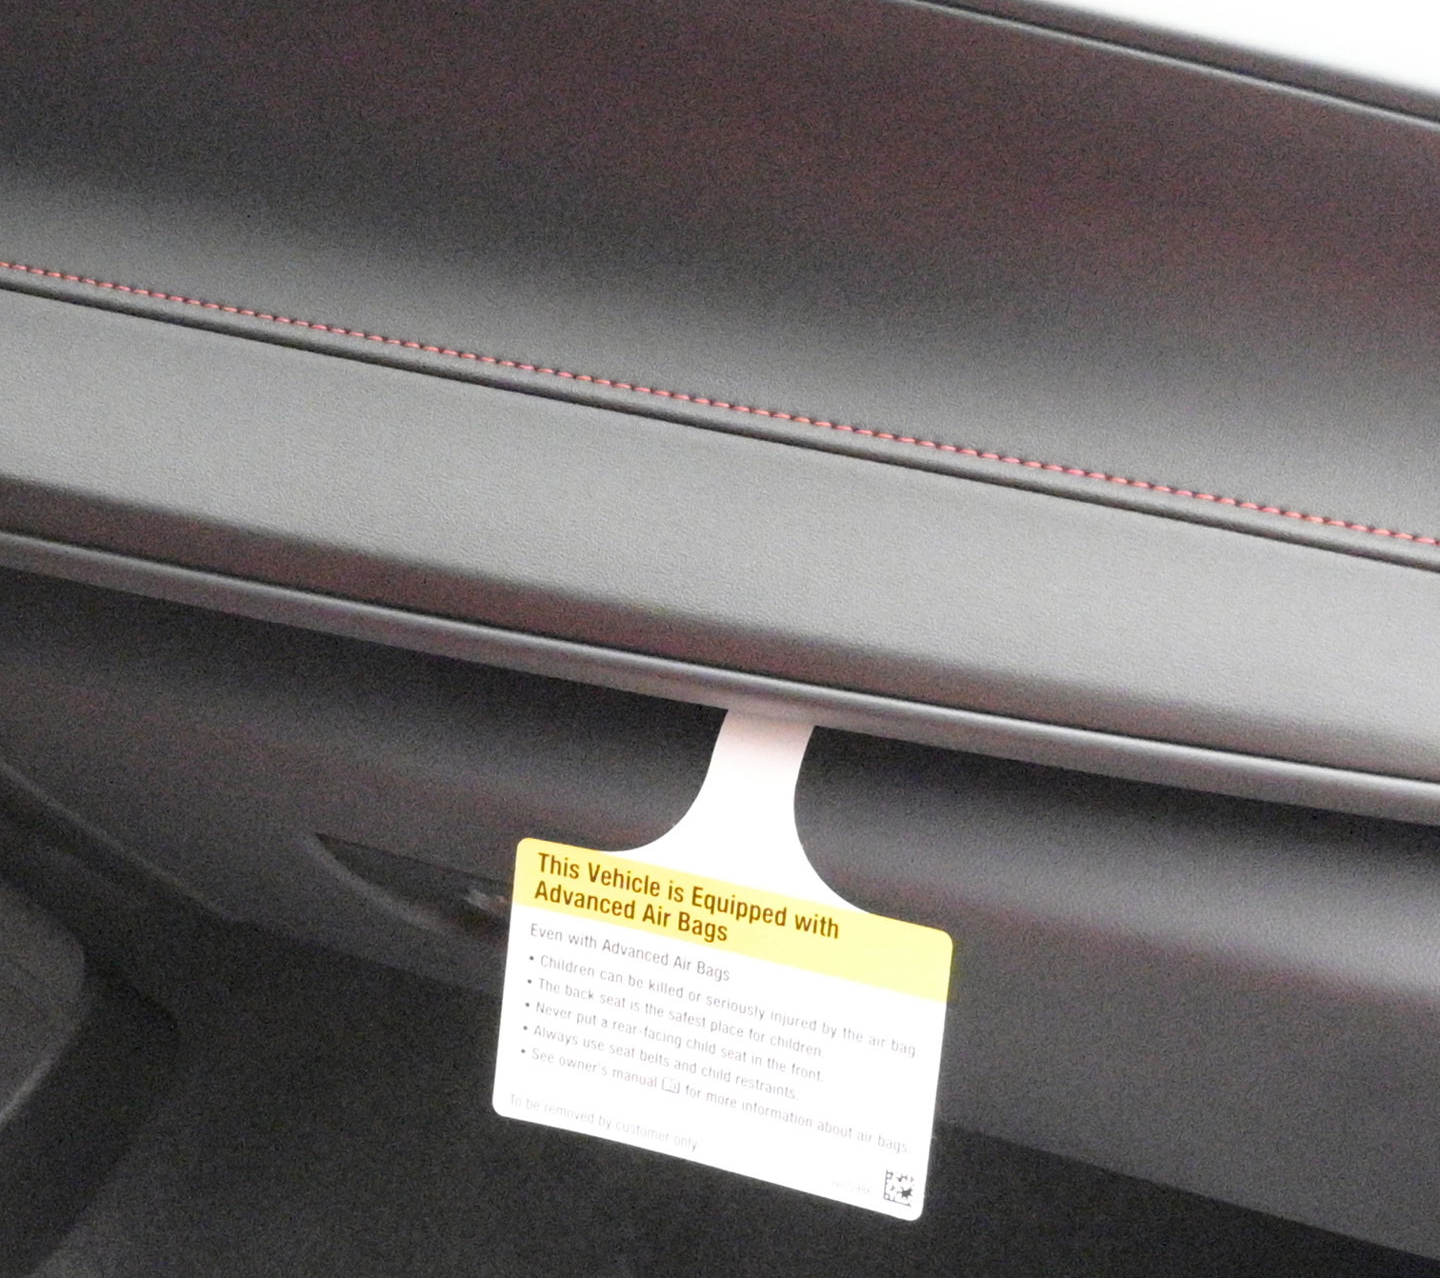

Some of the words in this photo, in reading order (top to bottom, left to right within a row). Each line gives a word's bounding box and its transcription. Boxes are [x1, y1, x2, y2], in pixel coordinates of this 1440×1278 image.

[533, 878, 637, 921] Advanced
[641, 902, 672, 929] Air
[677, 909, 728, 945] Bags
[537, 850, 580, 881] This
[587, 860, 661, 899] Vehicle
[667, 878, 685, 905] is
[691, 884, 788, 929] Equipped
[794, 912, 839, 941] with
[529, 921, 563, 944] Even
[567, 932, 598, 951] with
[601, 937, 670, 968] Advanced
[672, 953, 693, 973] Air
[696, 959, 731, 984] Bags
[535, 999, 574, 1021] Never
[576, 1011, 597, 1028] put
[600, 1017, 609, 1030] a
[611, 1019, 683, 1051] rear-facing
[685, 1036, 717, 1057] child
[720, 1046, 748, 1065] seat
[750, 1054, 763, 1068] in
[766, 1055, 787, 1074] the
[538, 975, 561, 996] The
[564, 982, 595, 1002] back
[599, 992, 627, 1010] seat
[629, 999, 641, 1013] is
[644, 1001, 665, 1019] the
[667, 1009, 707, 1031] safest
[709, 1018, 745, 1040] place
[748, 1026, 766, 1045] for
[539, 953, 596, 979] Children
[599, 969, 624, 986] can
[627, 972, 644, 991] be
[647, 977, 685, 1000] killed
[687, 989, 703, 1004] or
[705, 994, 766, 1022] seriously
[770, 1009, 818, 1033] injured
[821, 1020, 838, 1041] by
[842, 1025, 864, 1045] the
[867, 1033, 887, 1049] air
[532, 1023, 579, 1048] Always
[582, 1036, 605, 1053] use
[608, 1042, 636, 1060] seat
[639, 1047, 670, 1069] belts
[673, 1058, 698, 1076] and
[700, 1064, 732, 1085] child
[531, 1045, 555, 1065] See
[558, 1054, 608, 1078] owner's
[611, 1067, 659, 1089] manual
[684, 1082, 703, 1100] for
[704, 1090, 738, 1110] more
[741, 1100, 814, 1130] information
[816, 1119, 853, 1140] about
[856, 1130, 874, 1144] air
